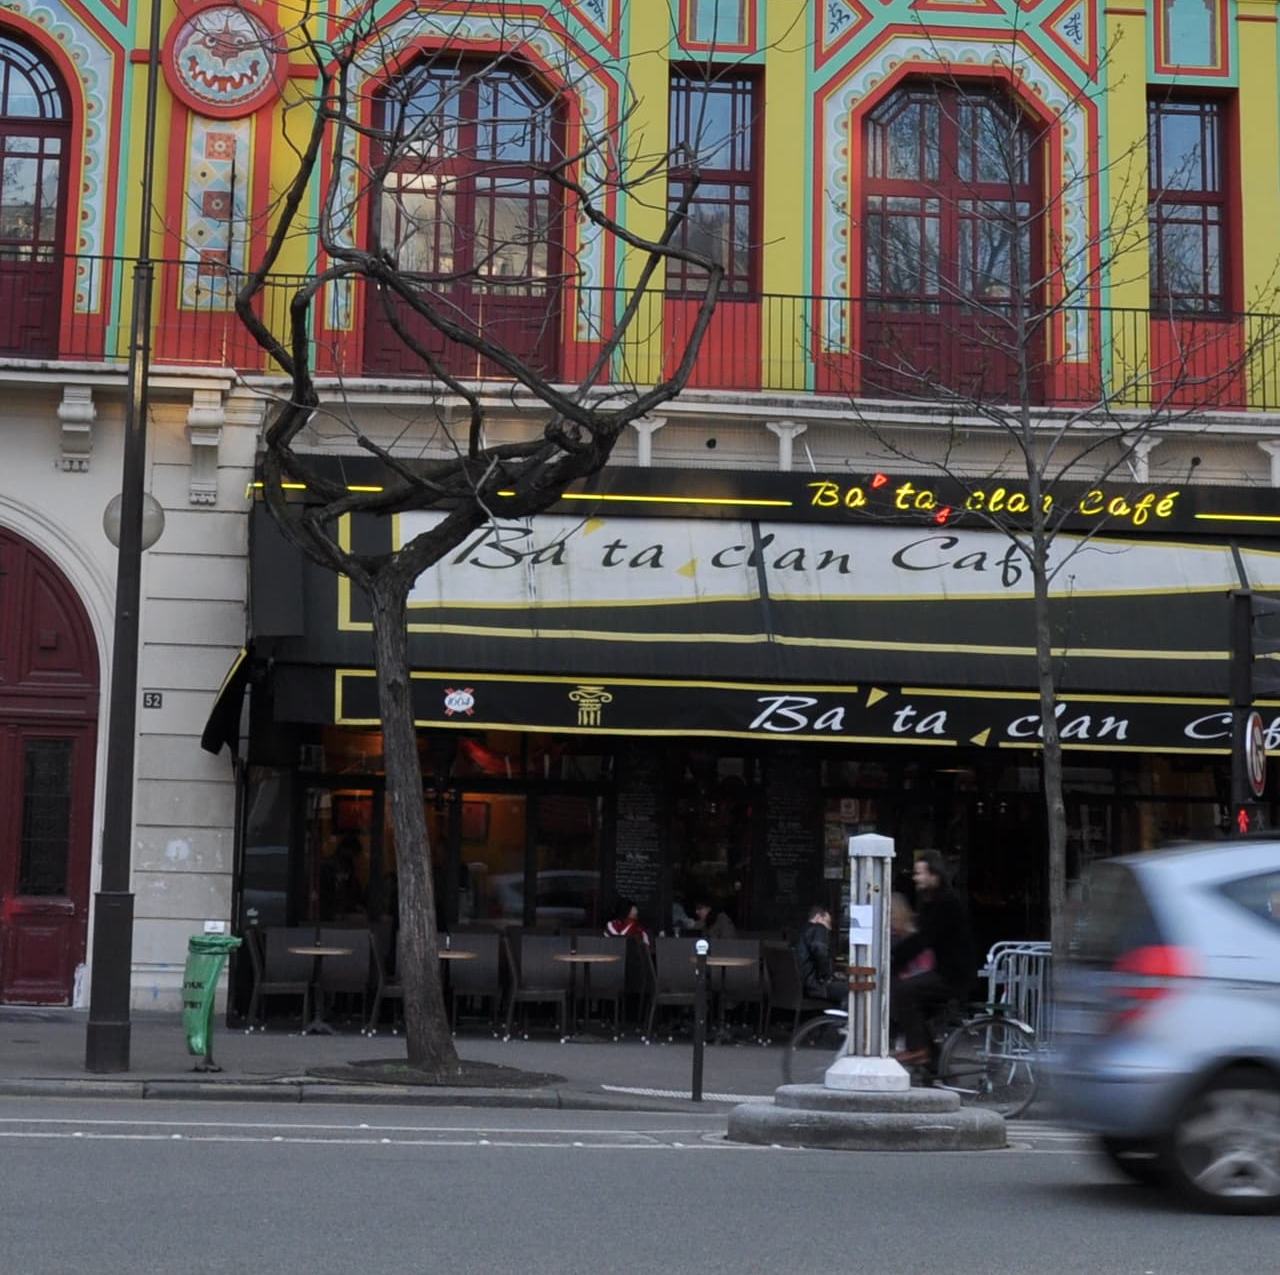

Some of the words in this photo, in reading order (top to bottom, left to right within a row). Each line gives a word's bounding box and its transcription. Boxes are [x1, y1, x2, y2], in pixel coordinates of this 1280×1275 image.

[1079, 491, 1179, 525] Café
[891, 536, 1052, 588] Caf
[145, 694, 161, 707] 52
